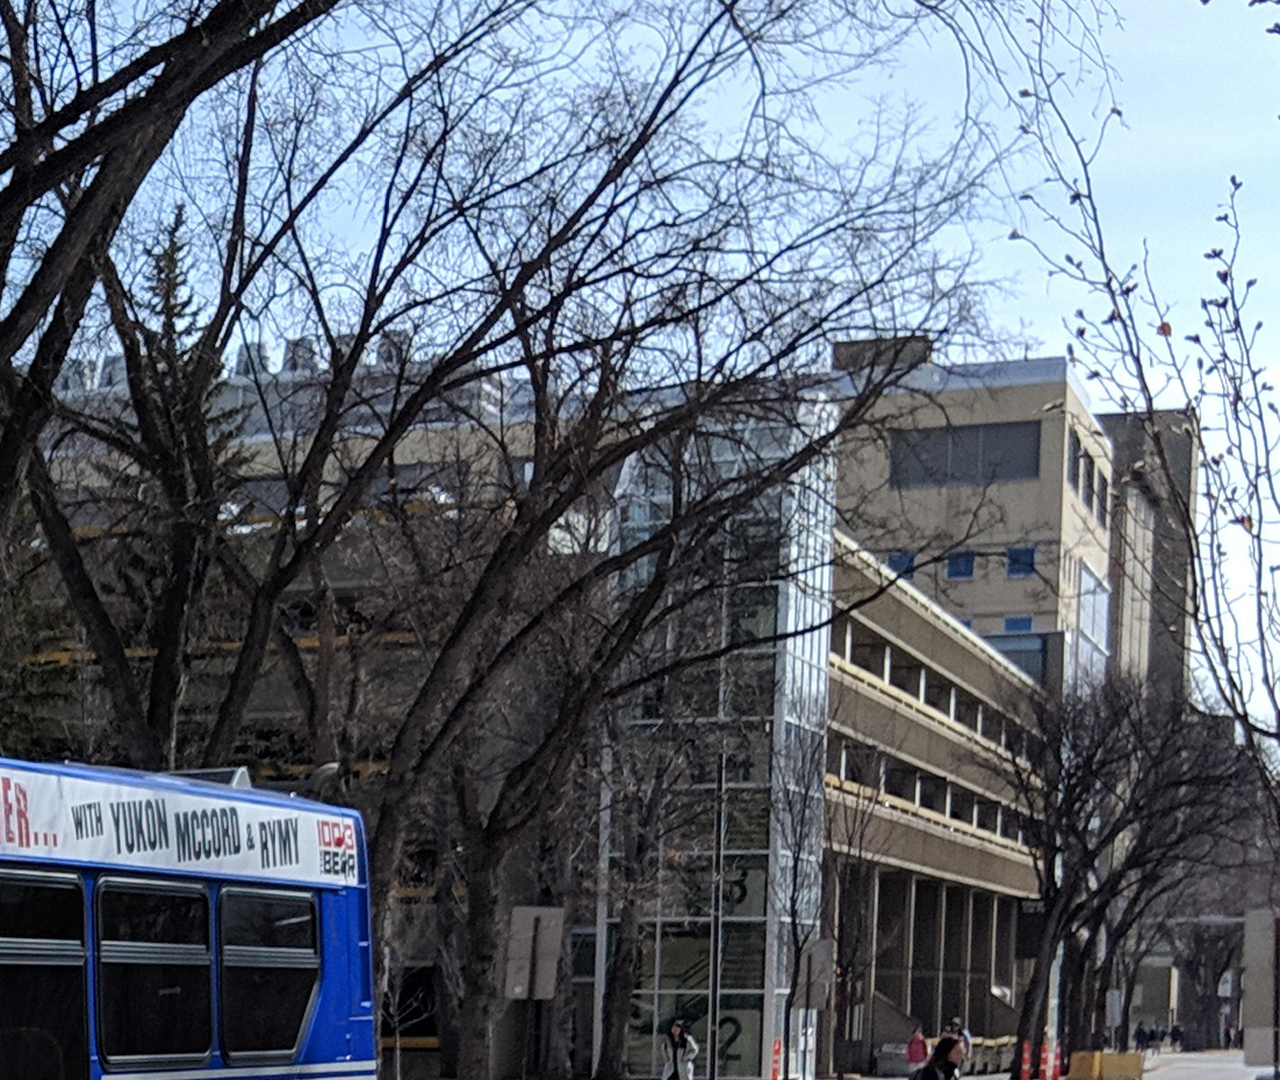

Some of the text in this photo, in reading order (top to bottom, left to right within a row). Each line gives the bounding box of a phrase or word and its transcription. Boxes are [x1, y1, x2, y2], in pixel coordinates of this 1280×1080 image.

[71, 802, 104, 841] WITH
[109, 799, 170, 855] YUKON
[174, 806, 240, 863] MCCORD
[246, 823, 255, 850] &
[258, 817, 300, 869] RYMY
[719, 1017, 742, 1060] 2
